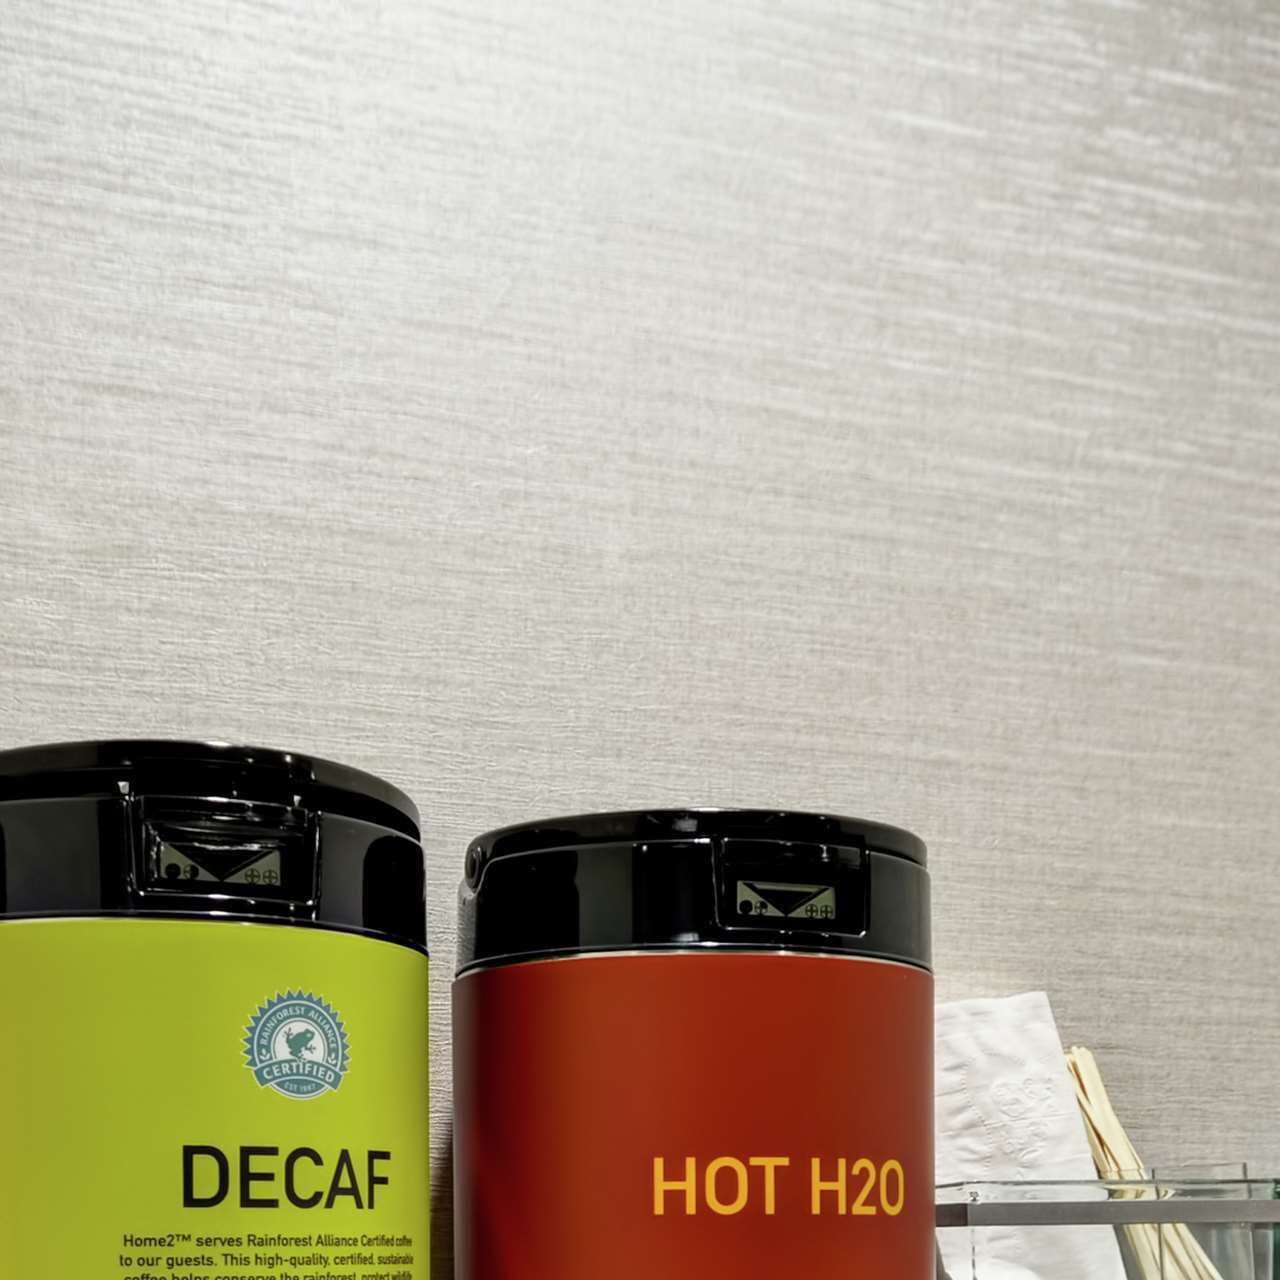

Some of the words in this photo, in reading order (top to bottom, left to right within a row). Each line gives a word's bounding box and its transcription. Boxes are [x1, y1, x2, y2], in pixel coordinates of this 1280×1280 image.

[260, 1007, 305, 1045] RAINFOREST
[309, 1010, 337, 1048] ALLIANCE
[263, 1061, 335, 1082] CERTIFIED
[183, 1145, 391, 1209] DECAF
[653, 1156, 790, 1215] HOT
[196, 1236, 243, 1247] serves
[247, 1234, 312, 1247] Rainforest
[315, 1234, 358, 1247] Alliance
[361, 1234, 394, 1246] Certified
[120, 1254, 132, 1267] to
[137, 1256, 161, 1267] our
[166, 1254, 217, 1269] guests.
[222, 1253, 250, 1266] This
